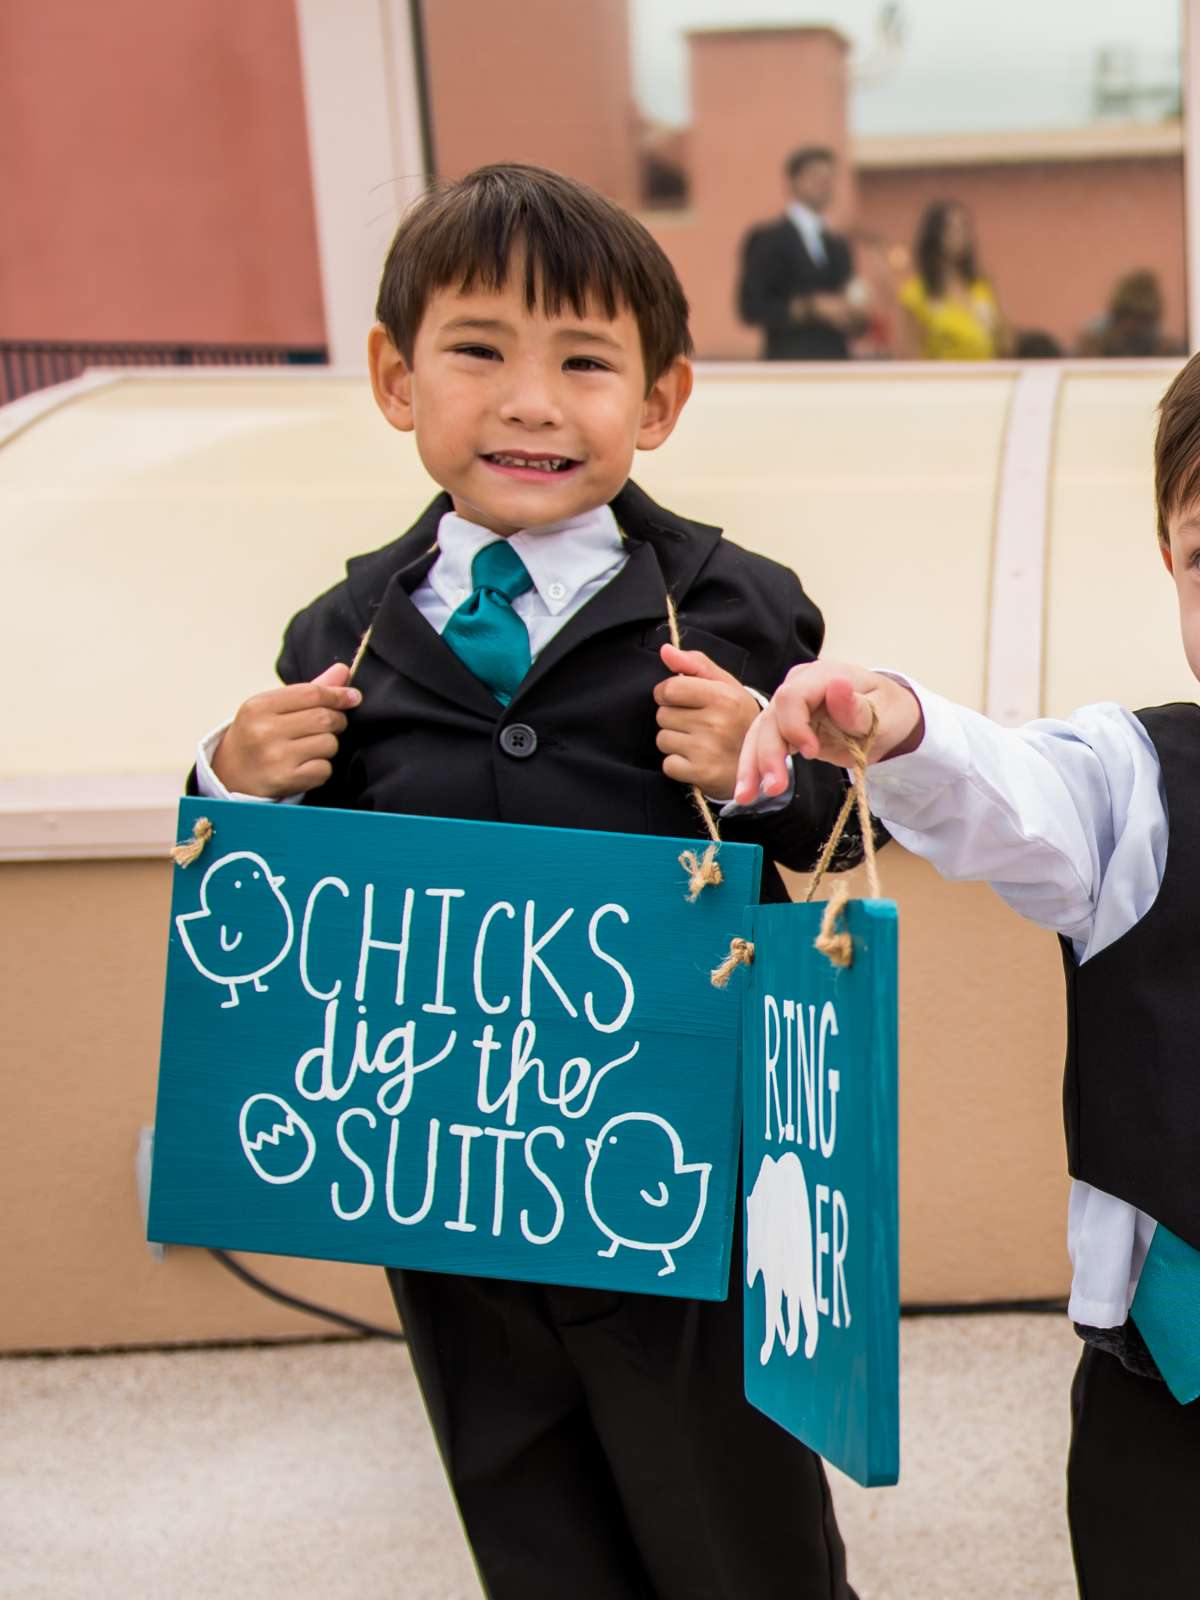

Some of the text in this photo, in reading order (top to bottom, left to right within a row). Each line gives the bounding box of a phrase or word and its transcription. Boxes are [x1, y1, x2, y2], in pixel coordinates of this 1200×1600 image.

[299, 876, 635, 1034] CHICKS
[294, 998, 640, 1126] dig the
[764, 995, 840, 1158] RING
[331, 1107, 565, 1245] SUITS
[816, 1184, 851, 1328] ER
